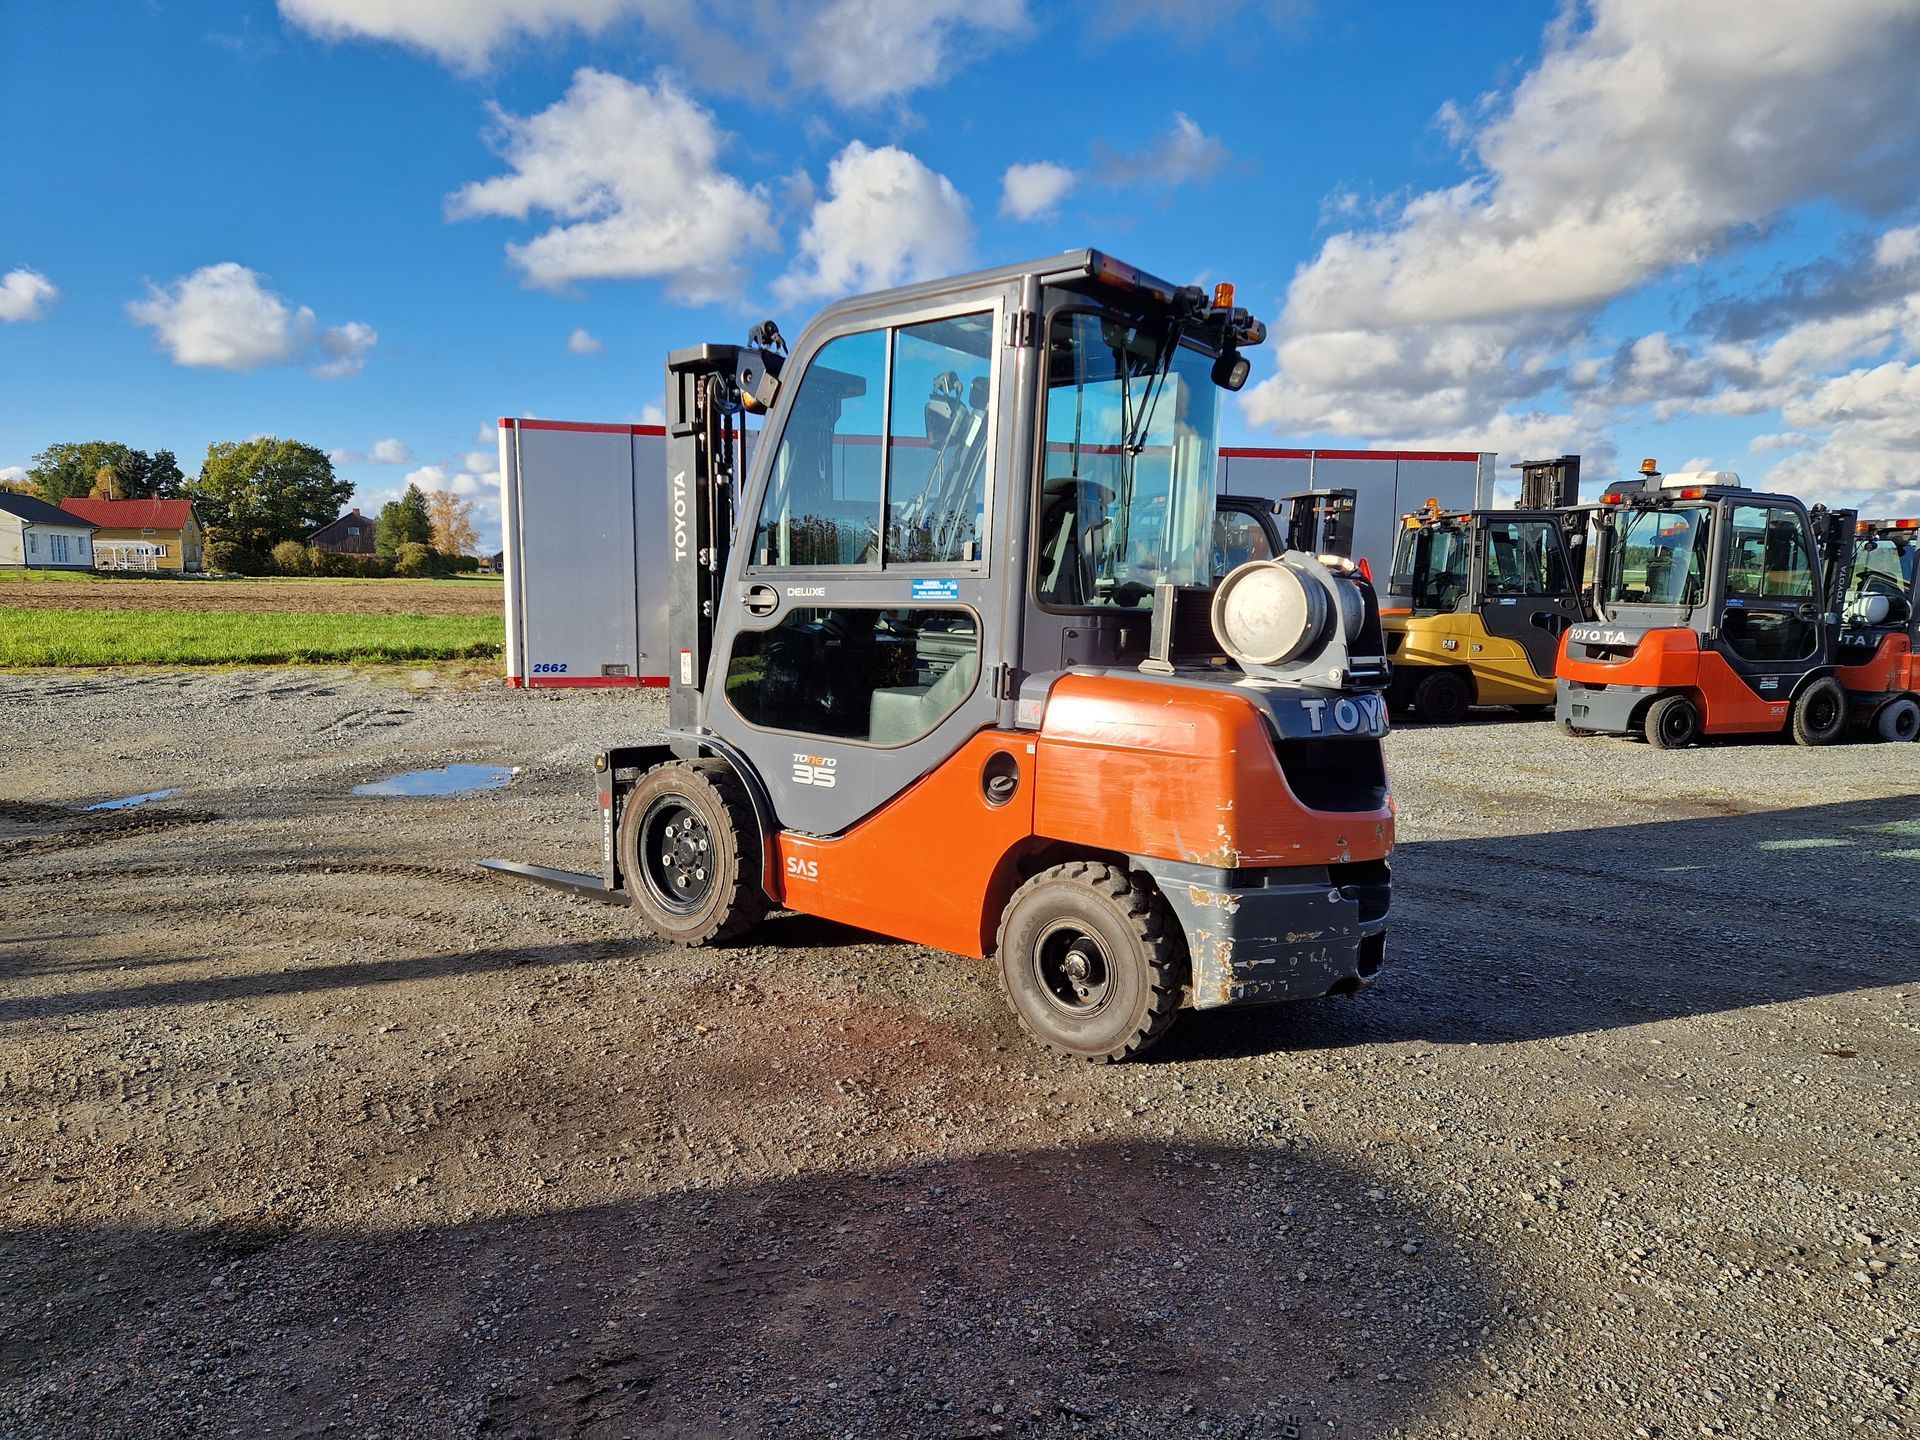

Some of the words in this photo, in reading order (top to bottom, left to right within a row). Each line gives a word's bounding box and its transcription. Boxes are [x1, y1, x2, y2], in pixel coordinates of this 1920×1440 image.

[674, 470, 687, 561] TOYOTA
[787, 587, 825, 597] DELUXE
[1836, 565, 1848, 604] TOYOTA
[1570, 628, 1626, 643] TOYOTA
[1442, 639, 1457, 650] CAT
[532, 663, 568, 673] 2662
[1771, 706, 1785, 714] SAS
[792, 764, 836, 788] 35
[787, 856, 818, 877] SAS
